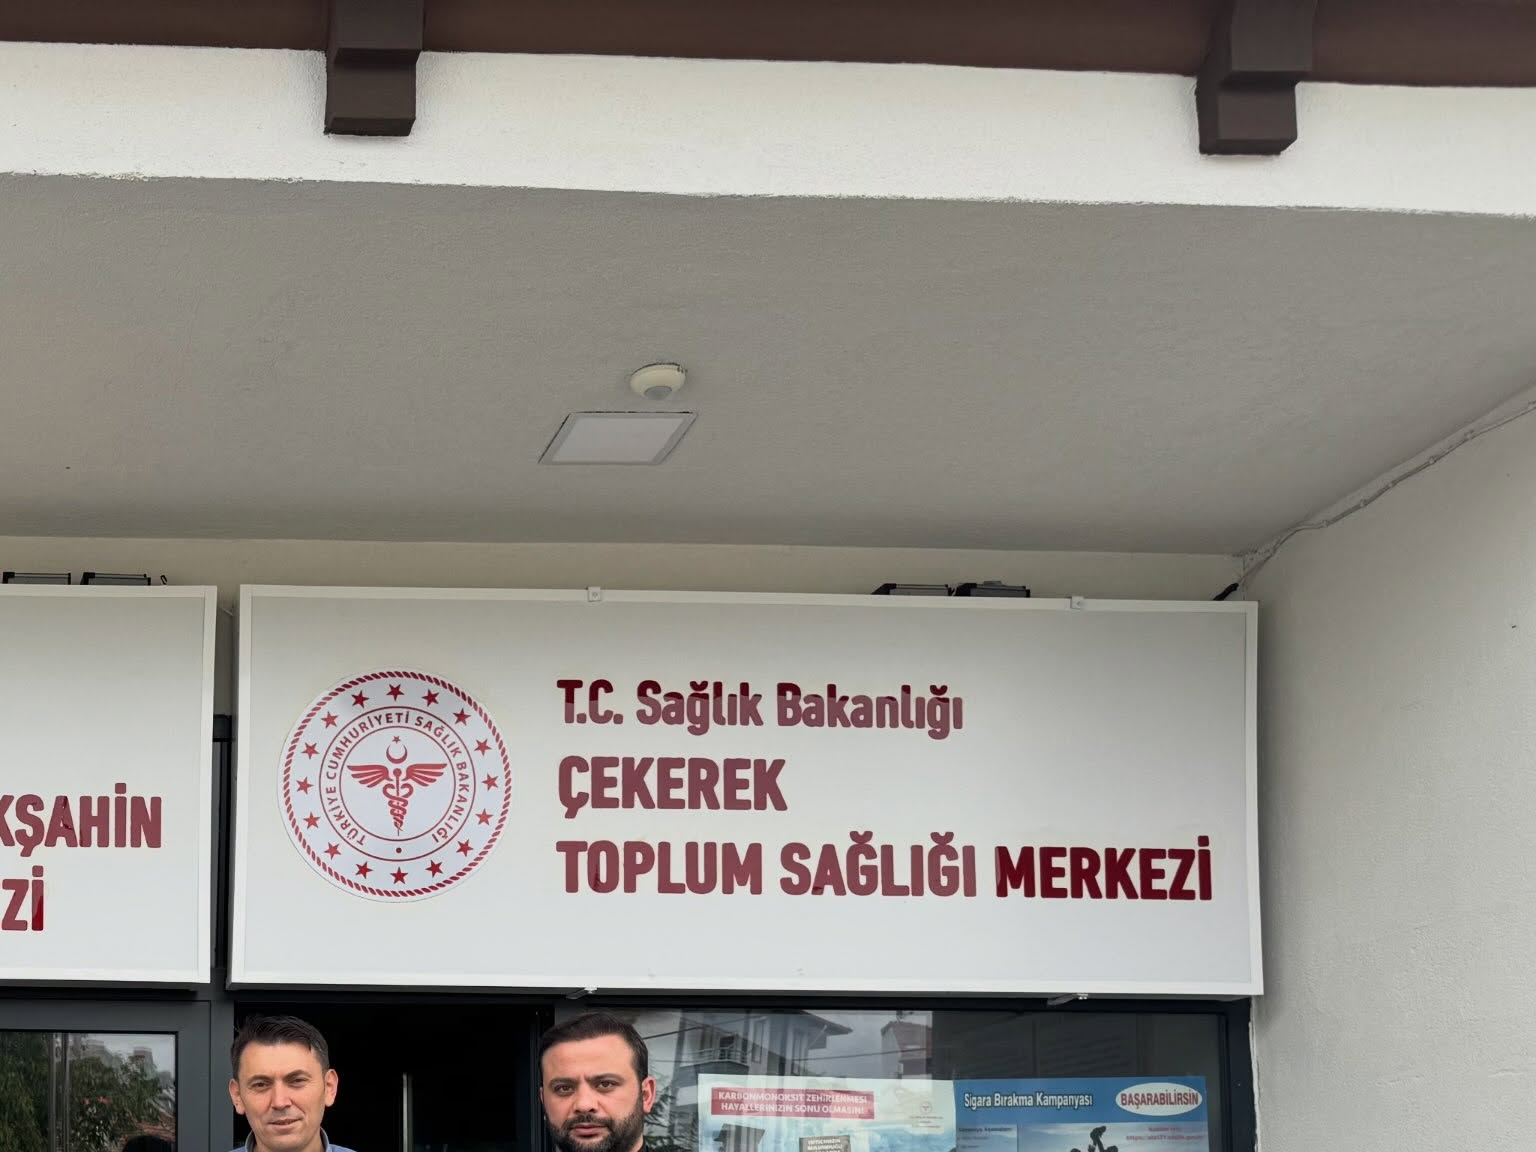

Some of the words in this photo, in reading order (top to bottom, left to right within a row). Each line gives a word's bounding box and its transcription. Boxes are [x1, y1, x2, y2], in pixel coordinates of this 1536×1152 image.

[414, 715, 462, 759] SAĞLIK
[557, 679, 624, 725] T.C.
[637, 680, 762, 735] Sağlık
[777, 682, 961, 739] Bakanlığı
[327, 711, 409, 780] CUMHURİYETİ
[326, 786, 366, 846] TÜRKİYE
[431, 761, 470, 844] BAKANLIĞI
[559, 756, 786, 818] ÇEKEREK
[556, 840, 763, 896] TOPLUM
[779, 831, 976, 898] SAĞLIĞI
[995, 836, 1212, 901] MERKEZİ
[794, 1104, 820, 1113] SONU
[964, 1093, 992, 1110] Sigara
[994, 1093, 1033, 1107] Bırakma
[1036, 1092, 1093, 1109] Kampanyası
[1120, 1089, 1199, 1109] BAŞARABİLİRSİN
